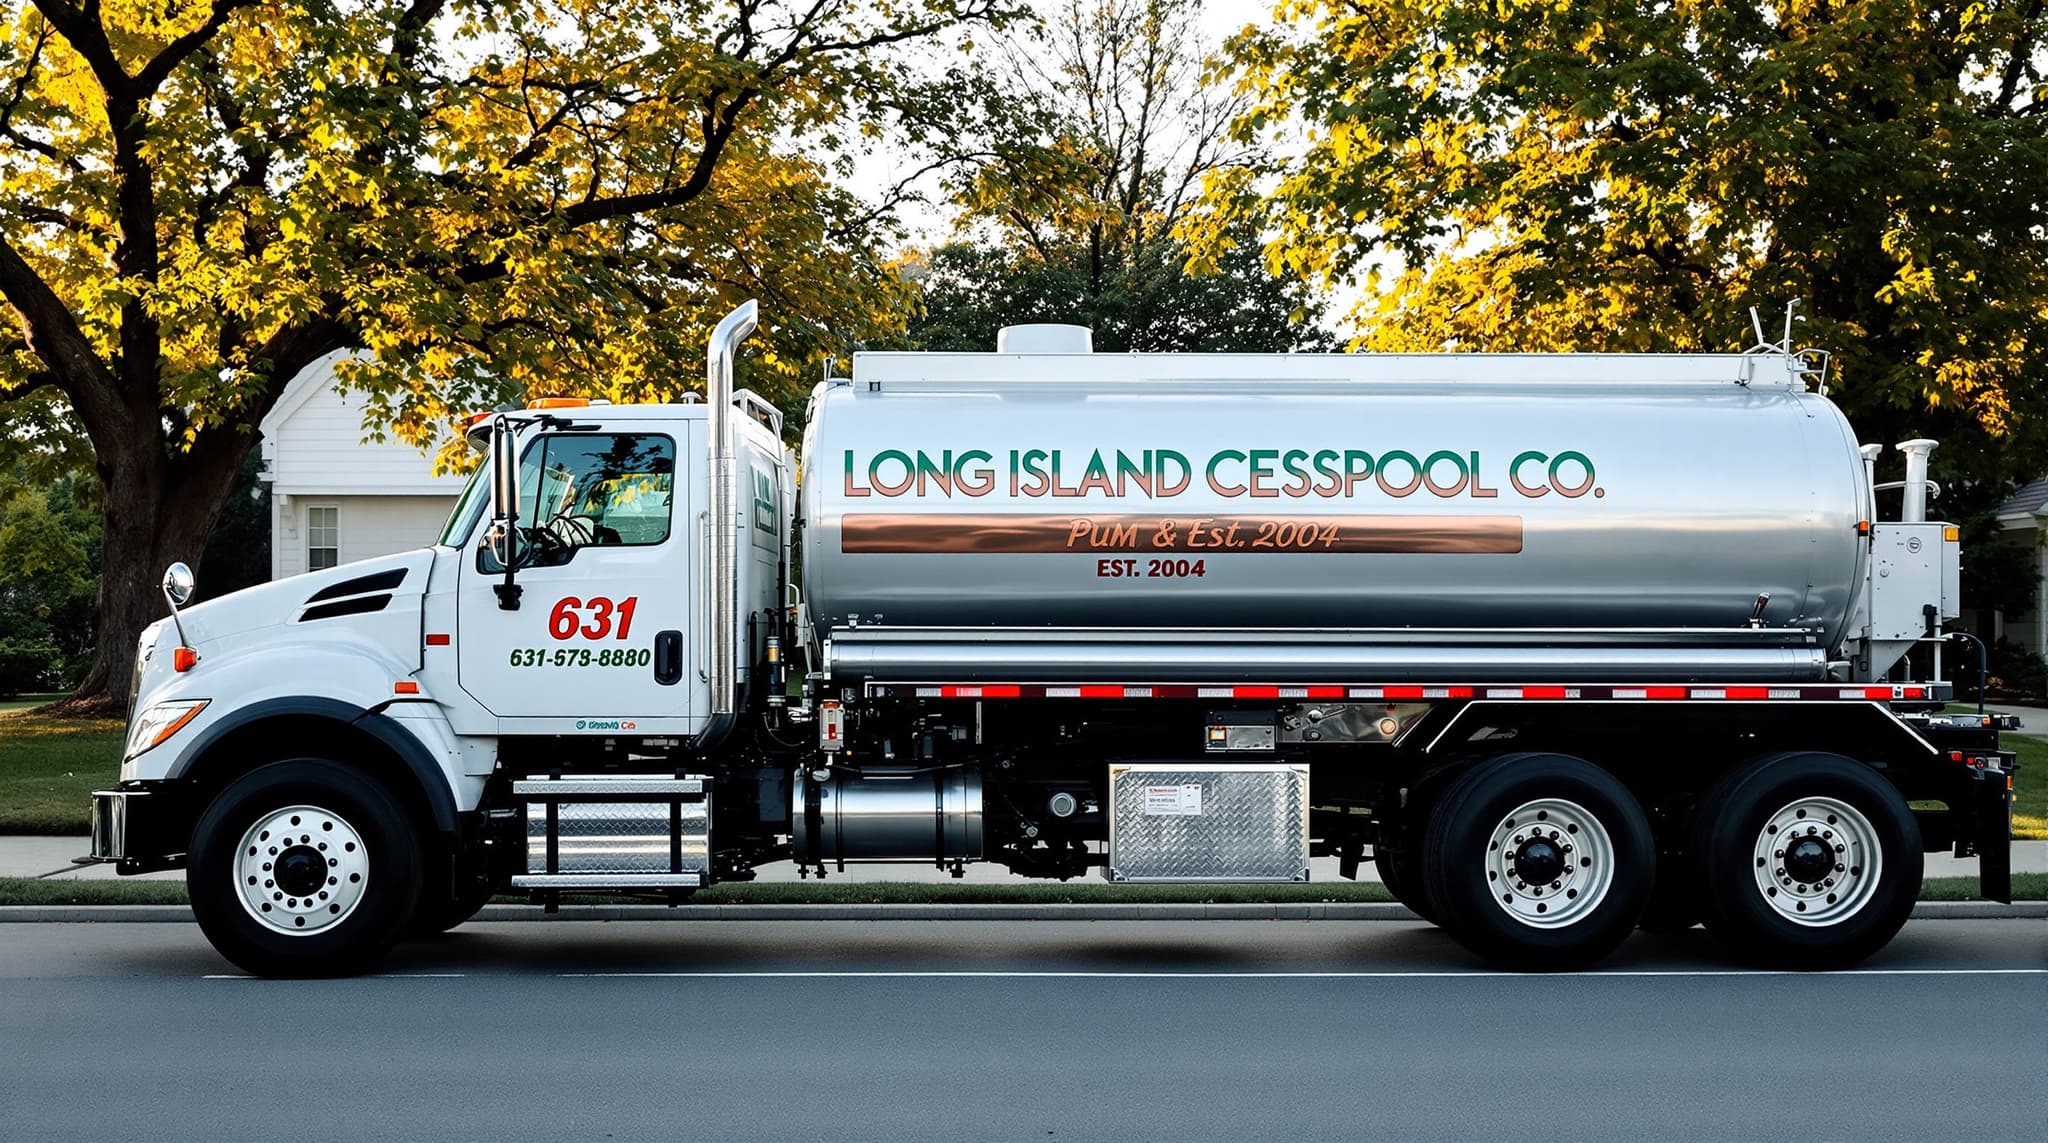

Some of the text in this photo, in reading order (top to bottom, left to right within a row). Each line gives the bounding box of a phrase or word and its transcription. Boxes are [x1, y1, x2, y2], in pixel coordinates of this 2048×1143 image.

[844, 448, 1606, 499] LONG ISLAND CESSPOOL CO.
[1152, 519, 1177, 548] &
[1187, 518, 1245, 548] Est.
[1252, 520, 1341, 548] 2004
[1097, 559, 1206, 577] EST. 2004
[549, 596, 638, 641] 631
